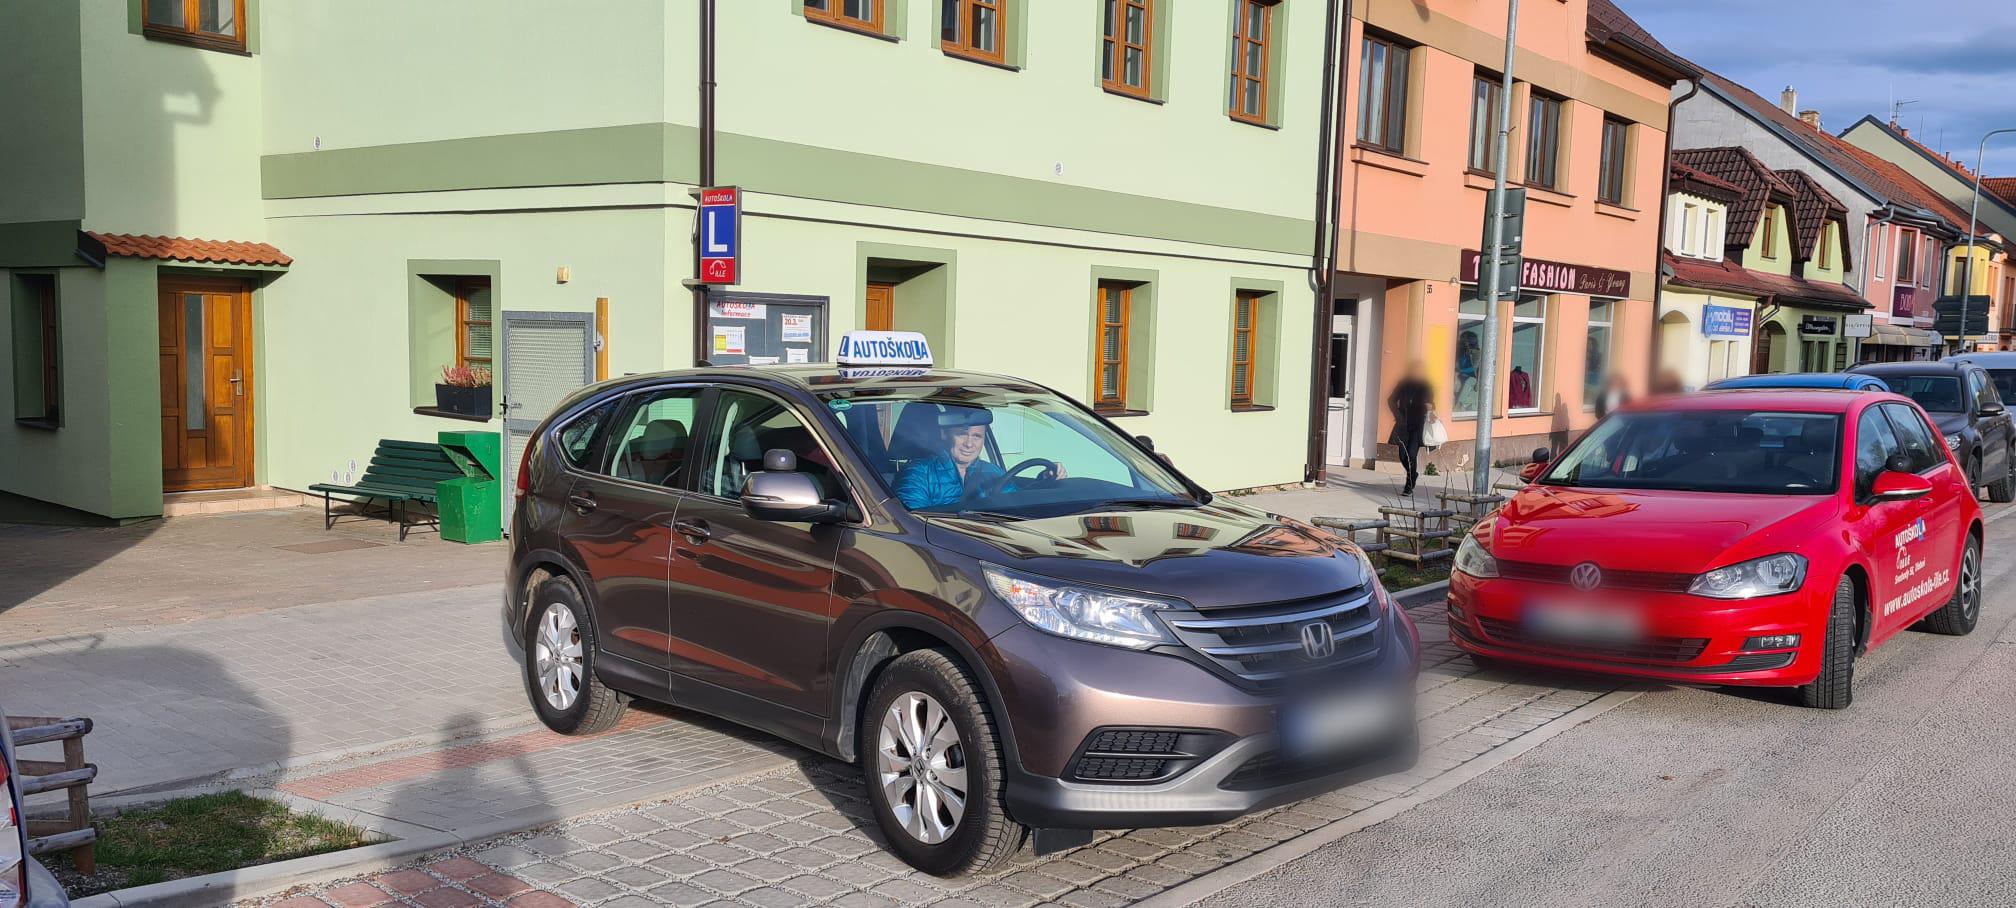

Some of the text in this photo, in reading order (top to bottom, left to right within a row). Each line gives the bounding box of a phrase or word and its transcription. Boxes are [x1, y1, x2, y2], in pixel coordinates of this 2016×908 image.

[708, 211, 728, 252] L
[1522, 262, 1576, 290] FASHION
[853, 337, 929, 359] AUTOŠKOLA
